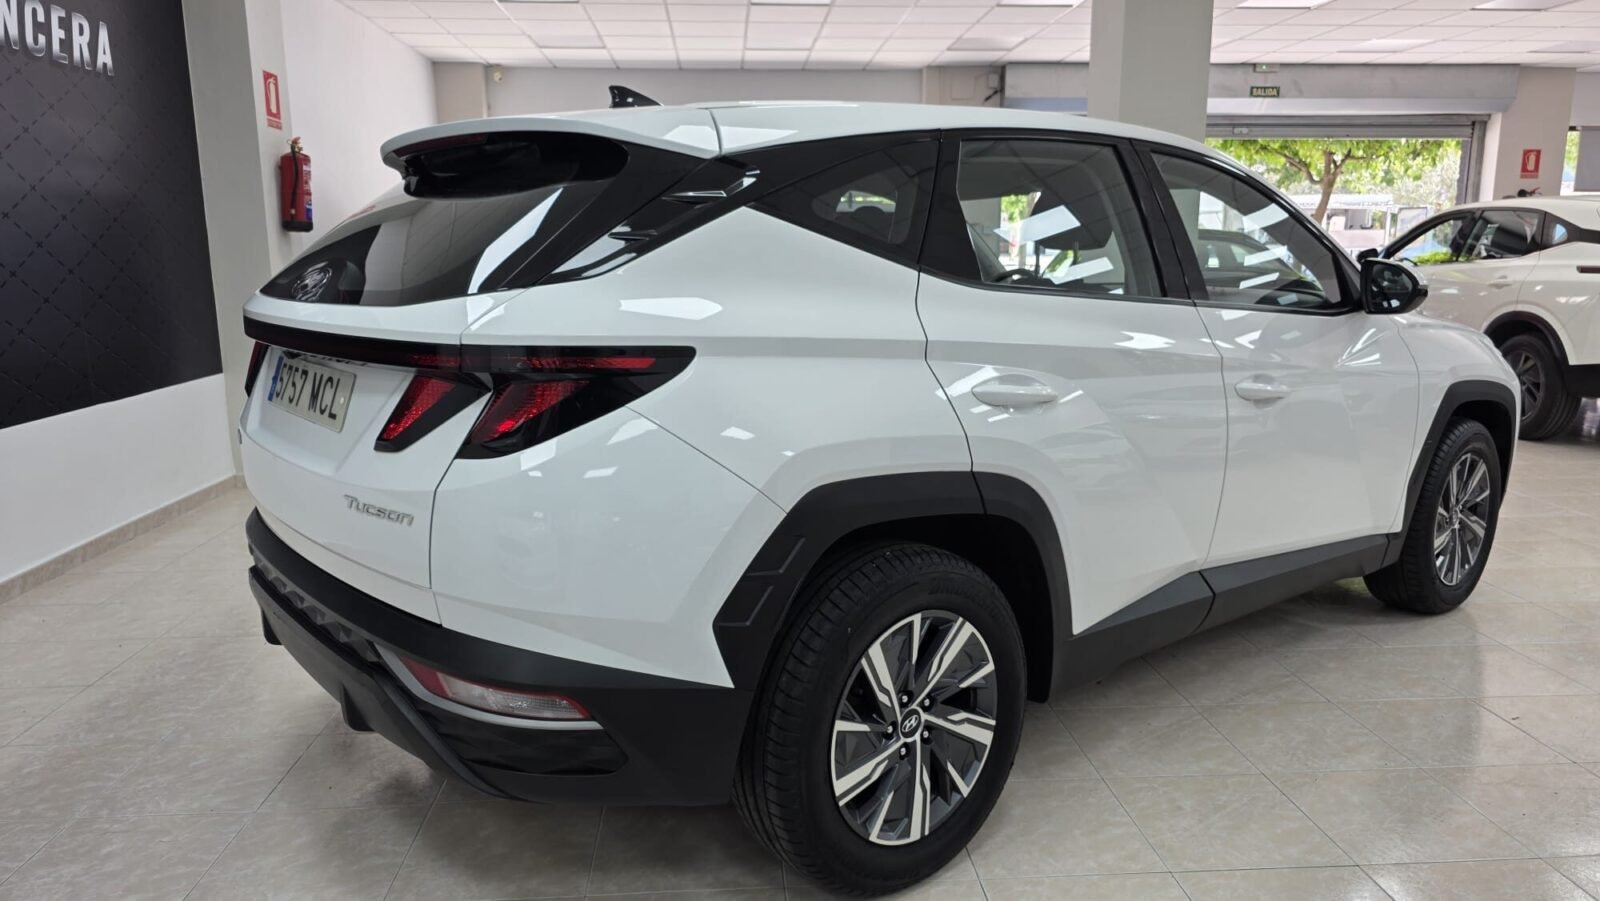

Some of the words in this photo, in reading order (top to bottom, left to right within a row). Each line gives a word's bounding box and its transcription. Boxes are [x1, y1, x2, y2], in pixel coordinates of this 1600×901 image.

[1252, 87, 1278, 96] SALIDA
[275, 362, 309, 407] 5757
[308, 371, 341, 420] MCL
[343, 494, 414, 527] Tucson
